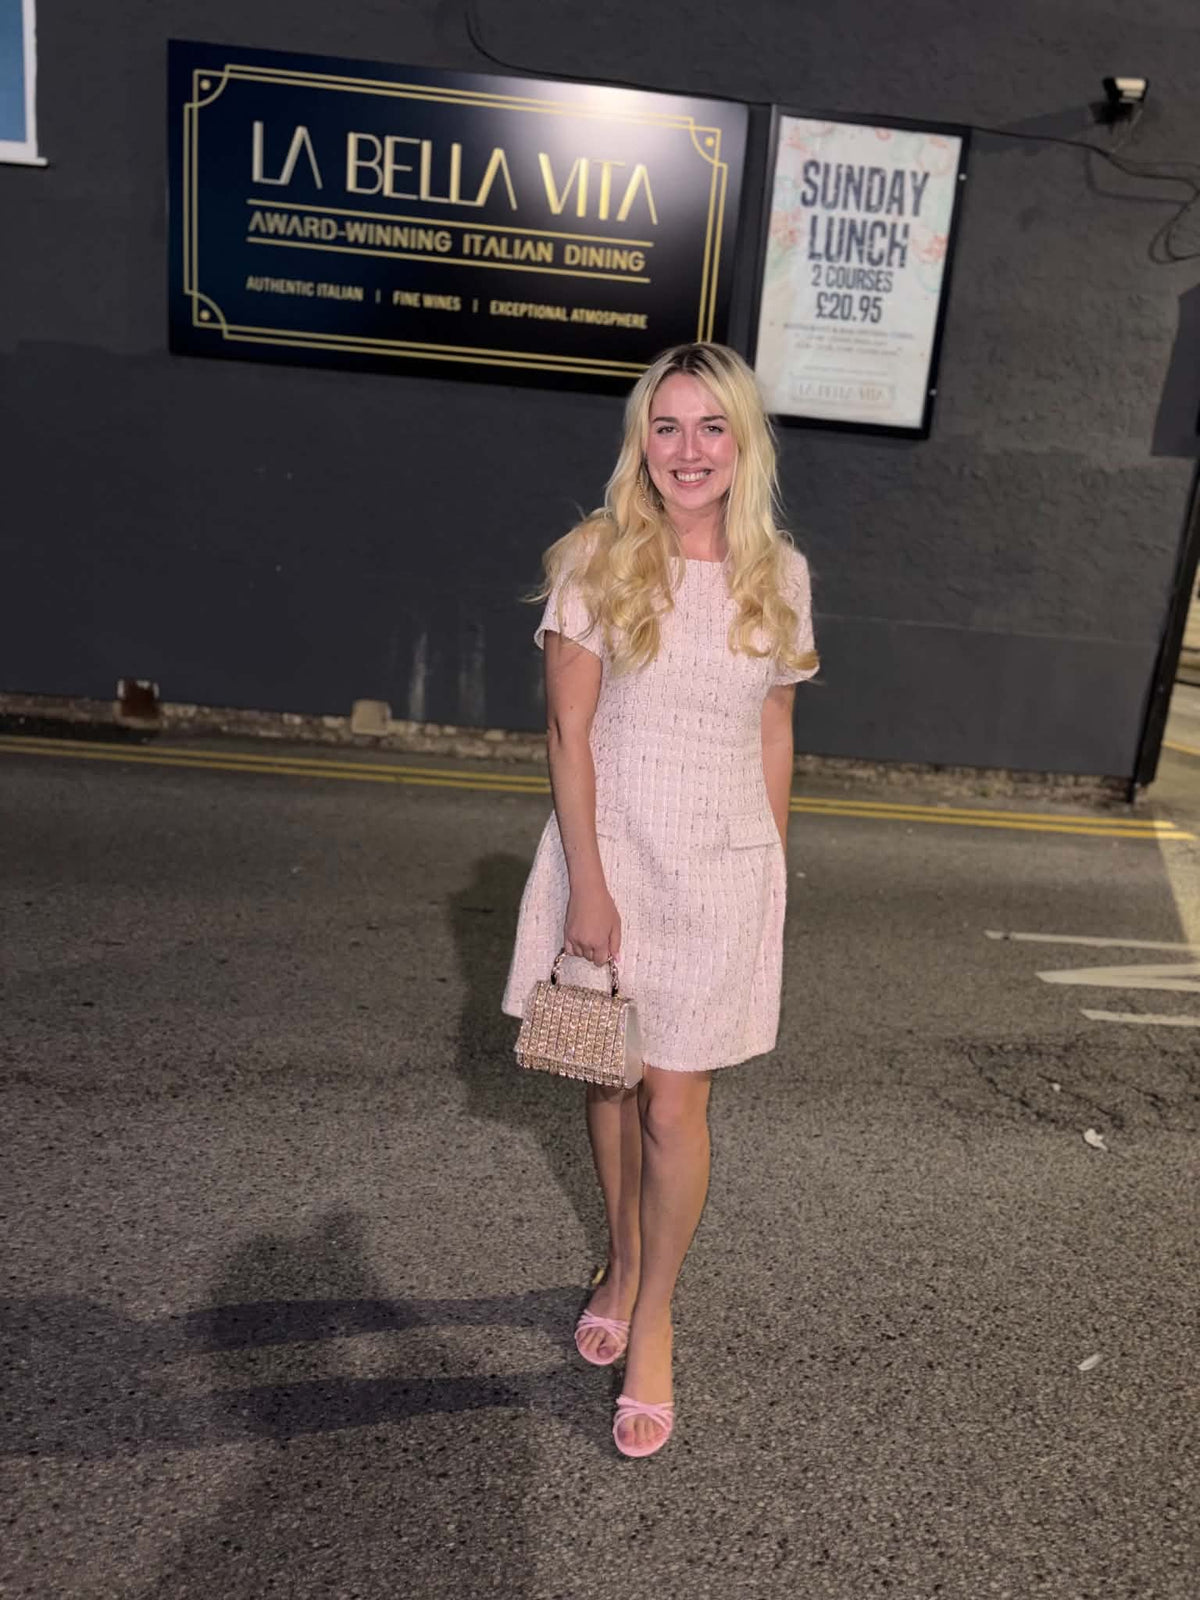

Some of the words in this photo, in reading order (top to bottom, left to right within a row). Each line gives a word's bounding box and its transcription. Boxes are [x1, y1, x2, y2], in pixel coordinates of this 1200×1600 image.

[252, 121, 323, 190] LA
[346, 131, 518, 211] BELLA
[538, 151, 658, 225] VITA
[801, 158, 930, 217] SUNDAY
[248, 211, 452, 252] AWARD-WINNING
[463, 233, 554, 263] ITALIAN
[564, 244, 645, 272] DINING
[808, 214, 909, 268] LUNCH
[246, 275, 314, 297] AUTHENTIC
[317, 282, 364, 301] ITALIAN
[392, 290, 420, 308] FINE
[423, 293, 461, 311] WINES
[490, 299, 568, 322] EXCEPTIONAL
[570, 308, 648, 330] ATMOSPHERE
[811, 264, 822, 286] 2
[825, 265, 894, 293] COURSES
[815, 291, 882, 323] £20.95
